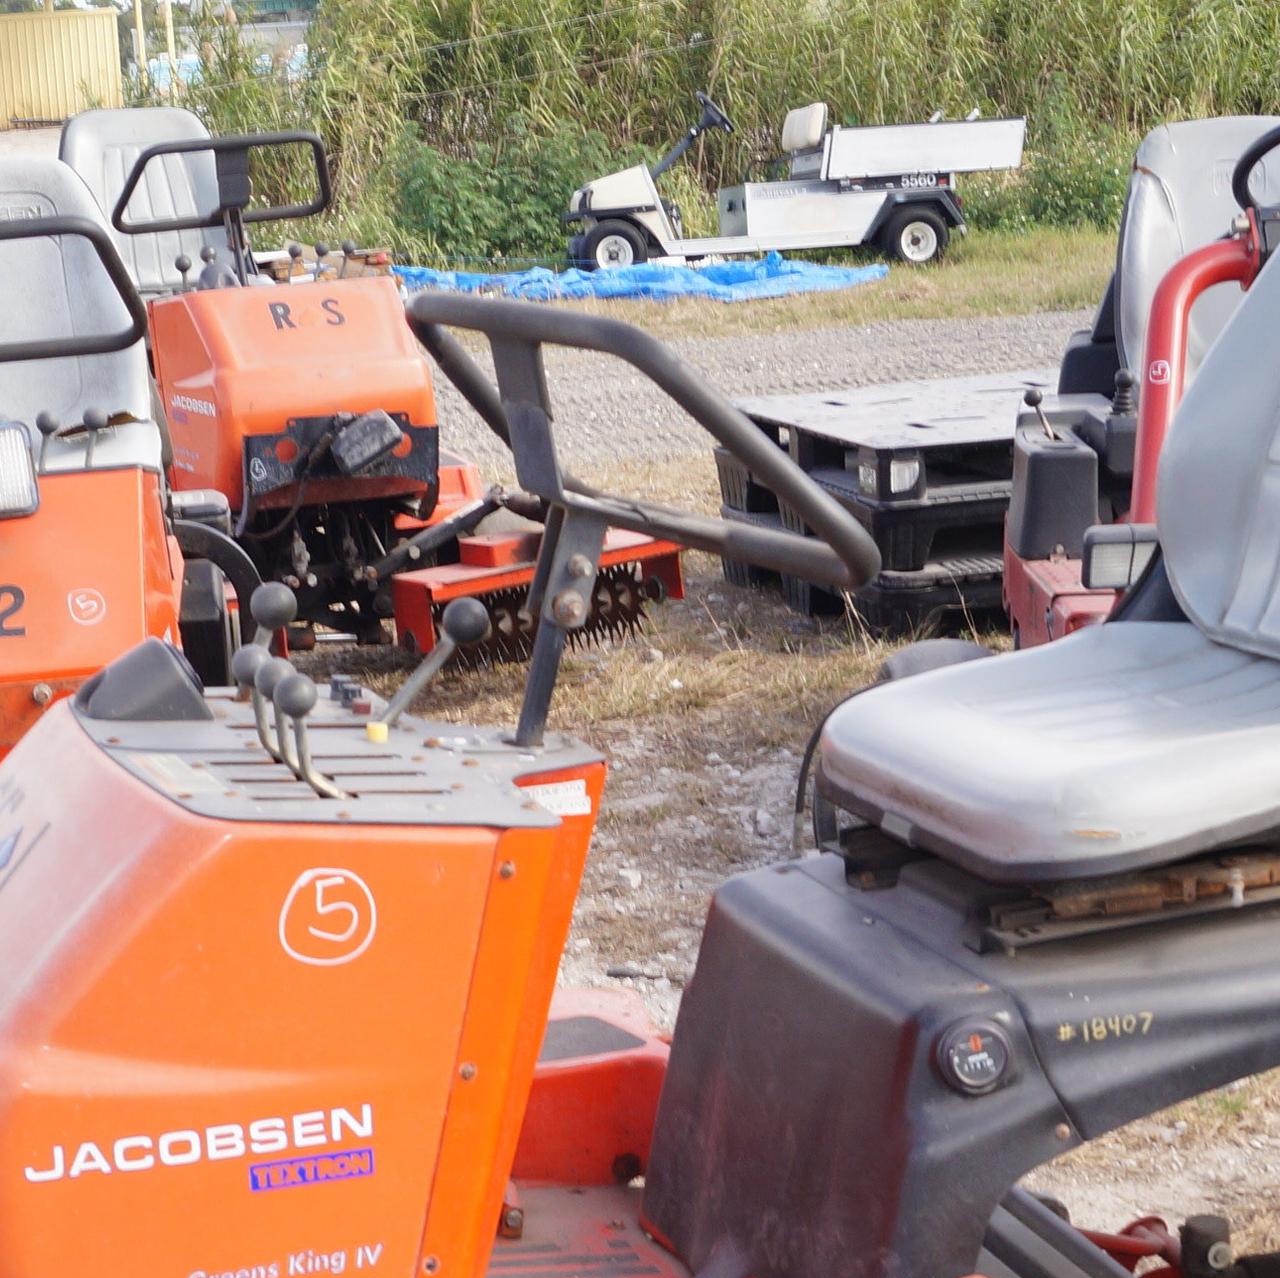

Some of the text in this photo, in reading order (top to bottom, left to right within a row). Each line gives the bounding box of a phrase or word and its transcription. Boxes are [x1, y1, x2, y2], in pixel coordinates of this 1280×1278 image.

[901, 173, 937, 189] 5560
[307, 876, 360, 943] 5
[1056, 1011, 1154, 1043] #18407
[24, 1103, 374, 1183] JACOBSEN
[252, 1149, 372, 1189] TEXTRON
[287, 1250, 347, 1277] King
[356, 1243, 383, 1267] IV
